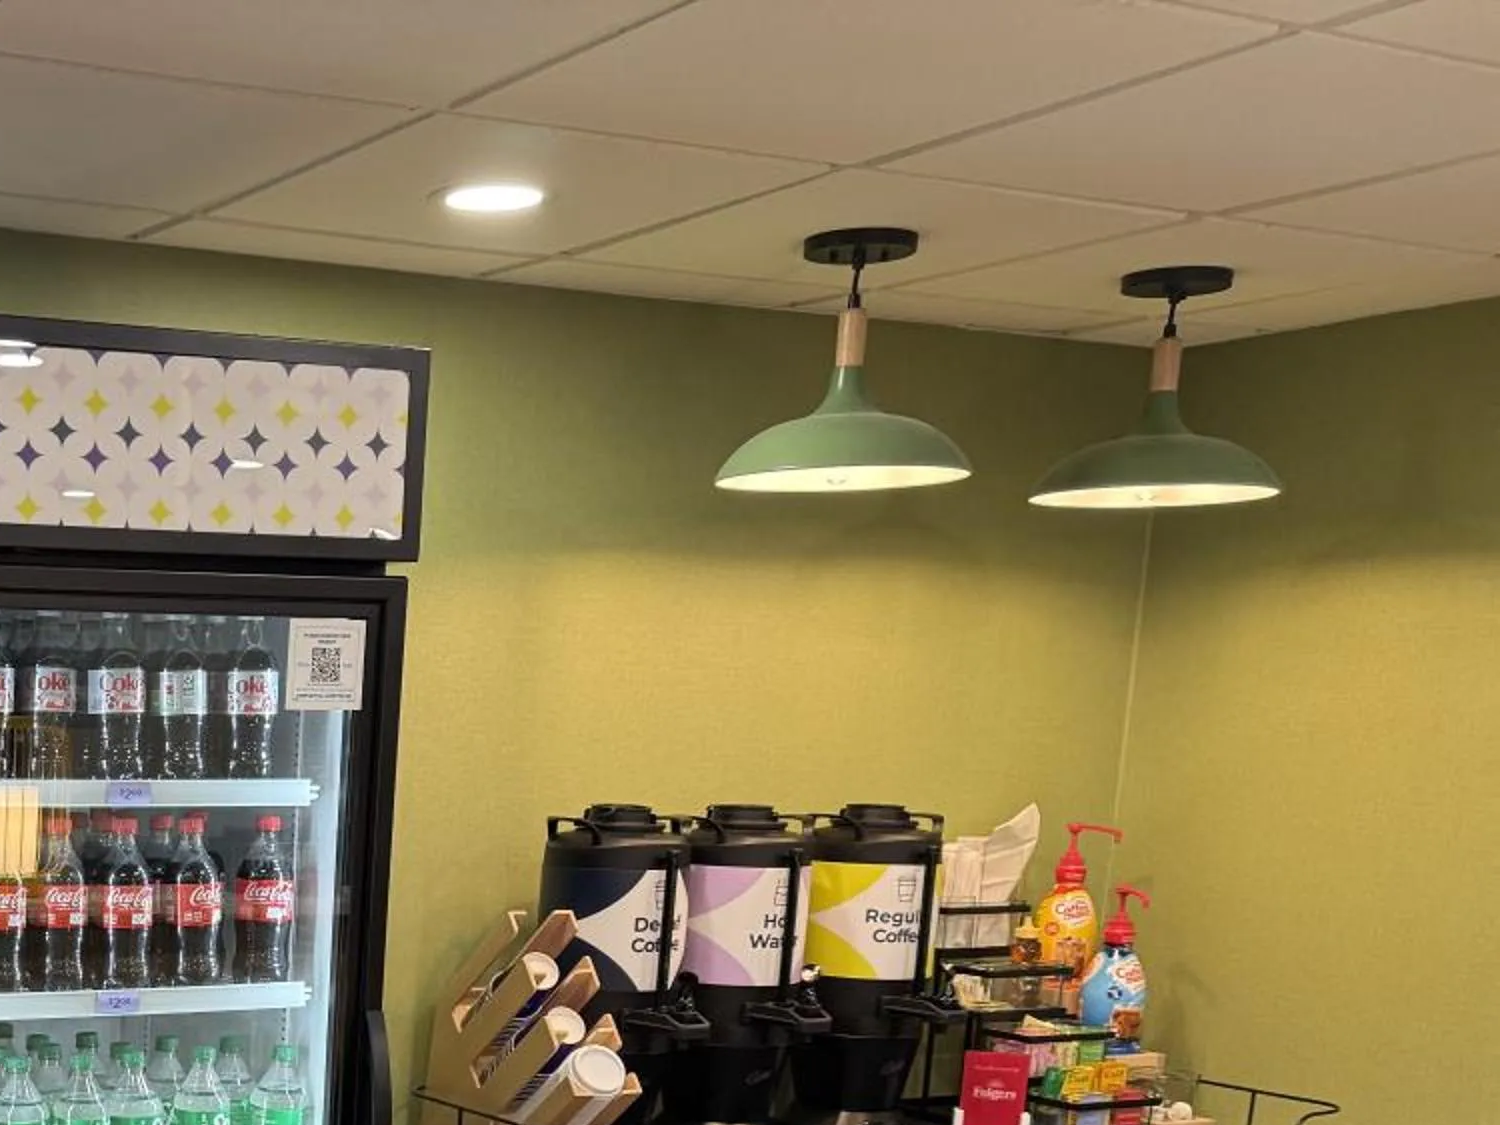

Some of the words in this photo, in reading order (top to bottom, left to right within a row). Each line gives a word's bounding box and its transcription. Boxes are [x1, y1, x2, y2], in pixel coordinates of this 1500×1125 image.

[763, 913, 787, 929] Ho
[872, 928, 920, 943] Coffe
[972, 1086, 1017, 1101] Folgers
